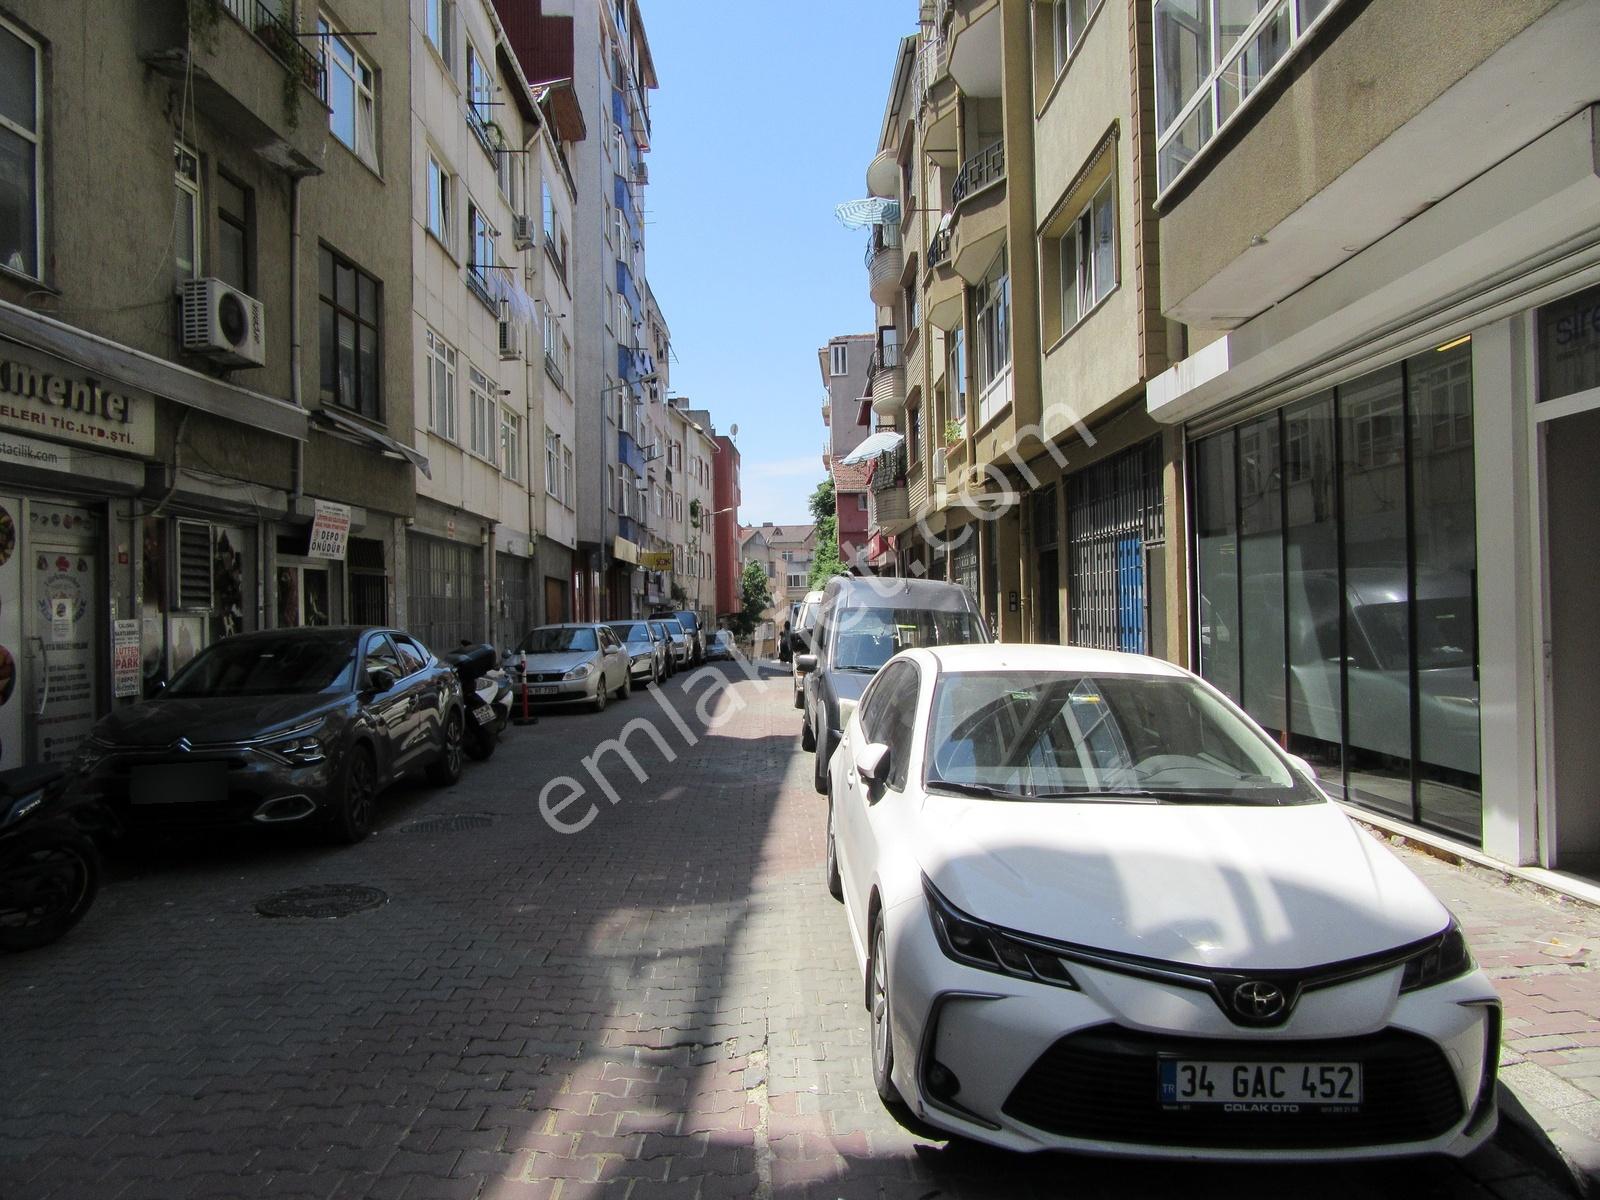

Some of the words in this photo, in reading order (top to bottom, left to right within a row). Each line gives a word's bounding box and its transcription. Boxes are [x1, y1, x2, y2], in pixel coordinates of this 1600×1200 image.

[321, 530, 339, 541] DEPO
[115, 657, 138, 669] PARK
[1180, 1065, 1215, 1098] 34
[1232, 1065, 1286, 1098] GAC
[1301, 1066, 1354, 1098] 452
[1271, 1103, 1299, 1113] OTO
